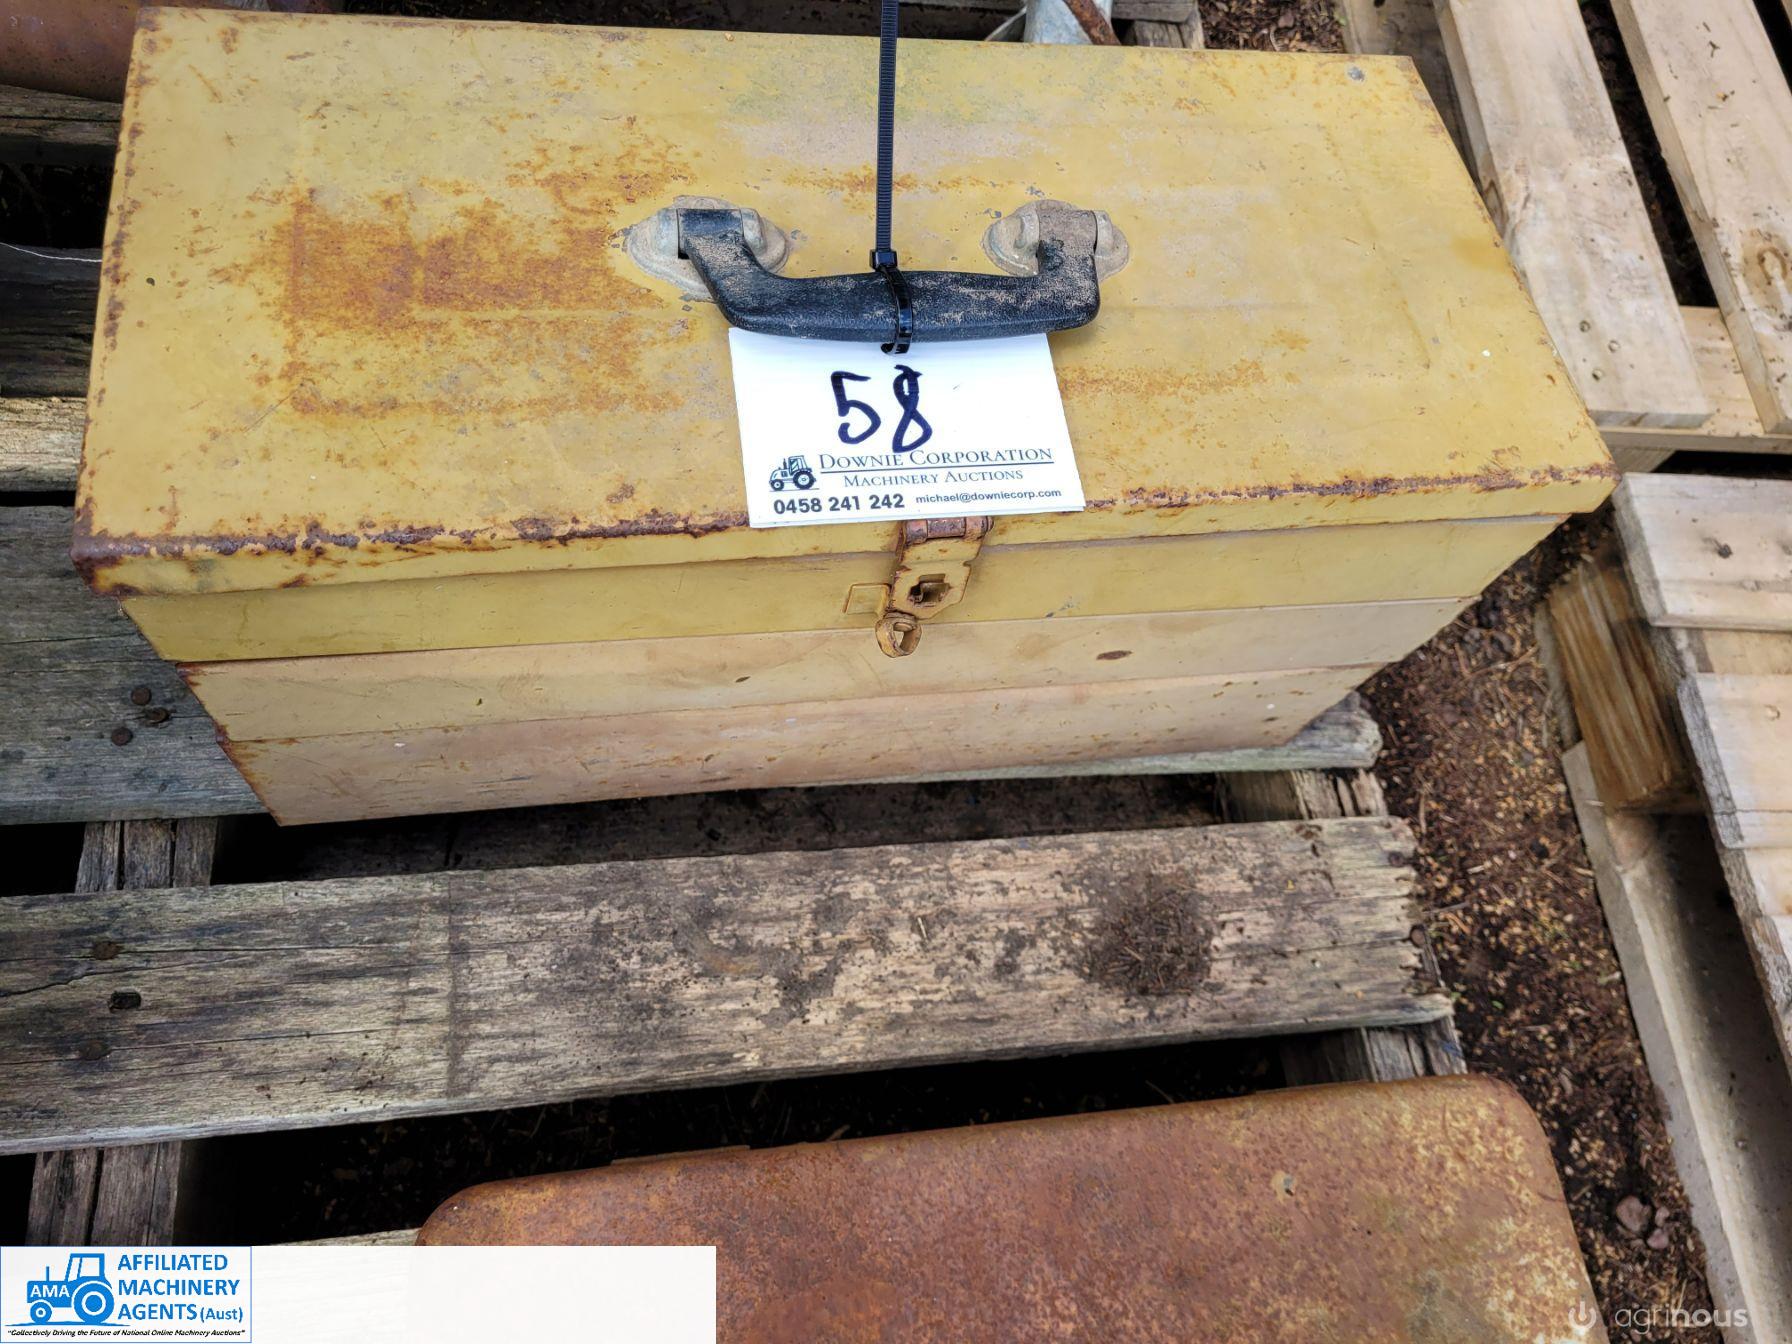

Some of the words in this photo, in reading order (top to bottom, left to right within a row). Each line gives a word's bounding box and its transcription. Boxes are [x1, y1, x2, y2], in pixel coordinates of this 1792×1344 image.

[831, 364, 933, 453] 58
[818, 453, 903, 471] DOWNIE
[909, 448, 1053, 467] CORPORATION
[844, 473, 939, 487] MACHINERY
[944, 470, 1024, 484] AUCTIONS
[773, 497, 823, 515] 0458
[828, 496, 861, 512] 241
[869, 493, 906, 510] 242
[915, 488, 1062, 504] michael@downiecorp.com
